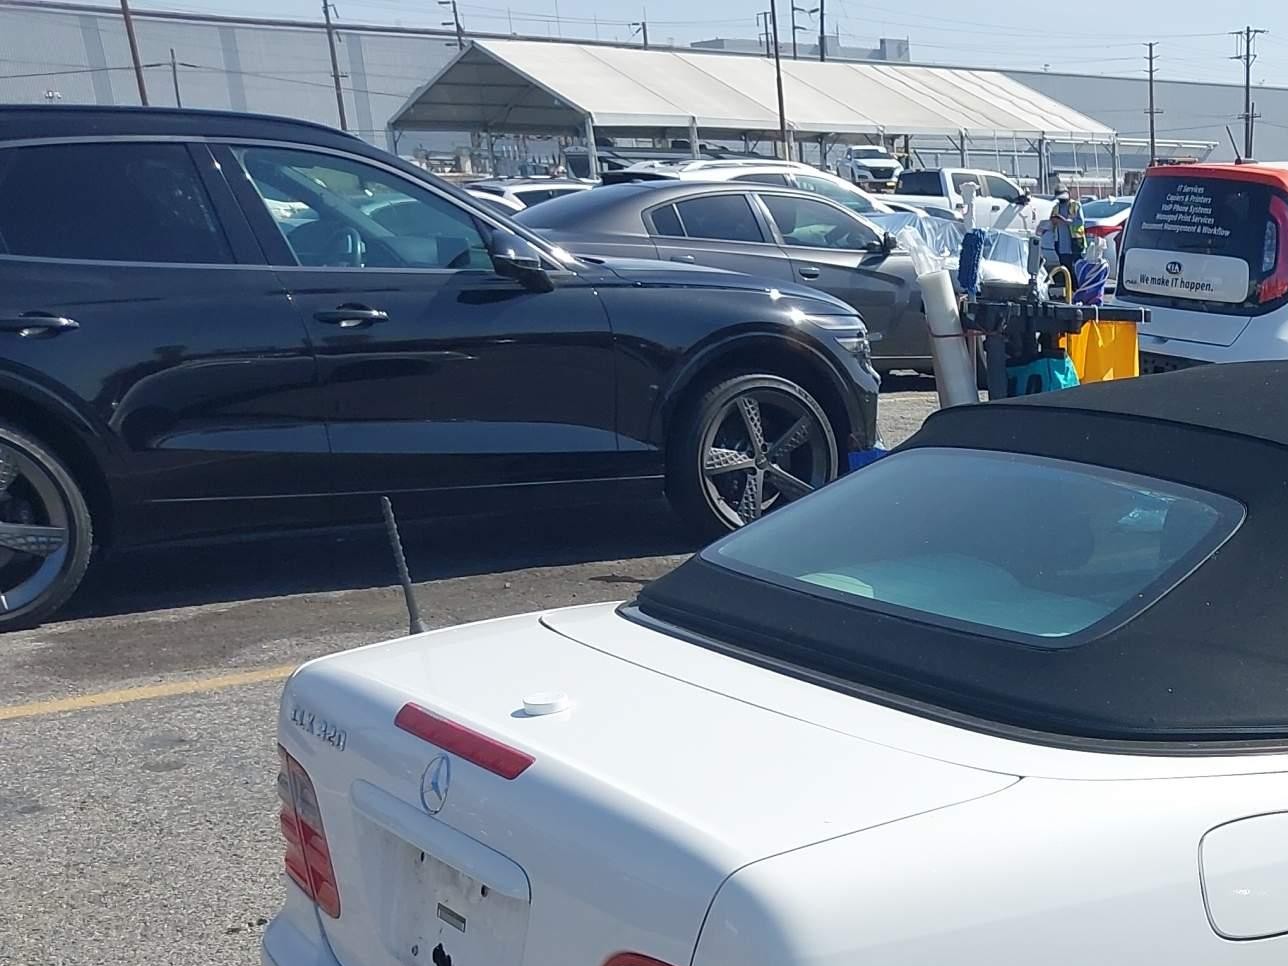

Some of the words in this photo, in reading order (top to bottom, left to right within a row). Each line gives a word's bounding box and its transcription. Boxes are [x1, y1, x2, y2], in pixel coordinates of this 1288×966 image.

[1183, 185, 1205, 194] Services
[1166, 194, 1184, 203] Copiers
[1189, 195, 1211, 204] Printers
[1173, 204, 1189, 212] Phone
[1189, 205, 1212, 214] Systems
[1178, 214, 1190, 222] Print
[1191, 214, 1215, 225] Services
[1164, 222, 1196, 234] Management
[1202, 225, 1231, 237] Workflow
[1139, 273, 1150, 284] We
[1150, 276, 1169, 287] make
[1171, 277, 1179, 287] IT
[1180, 277, 1214, 293] happen.
